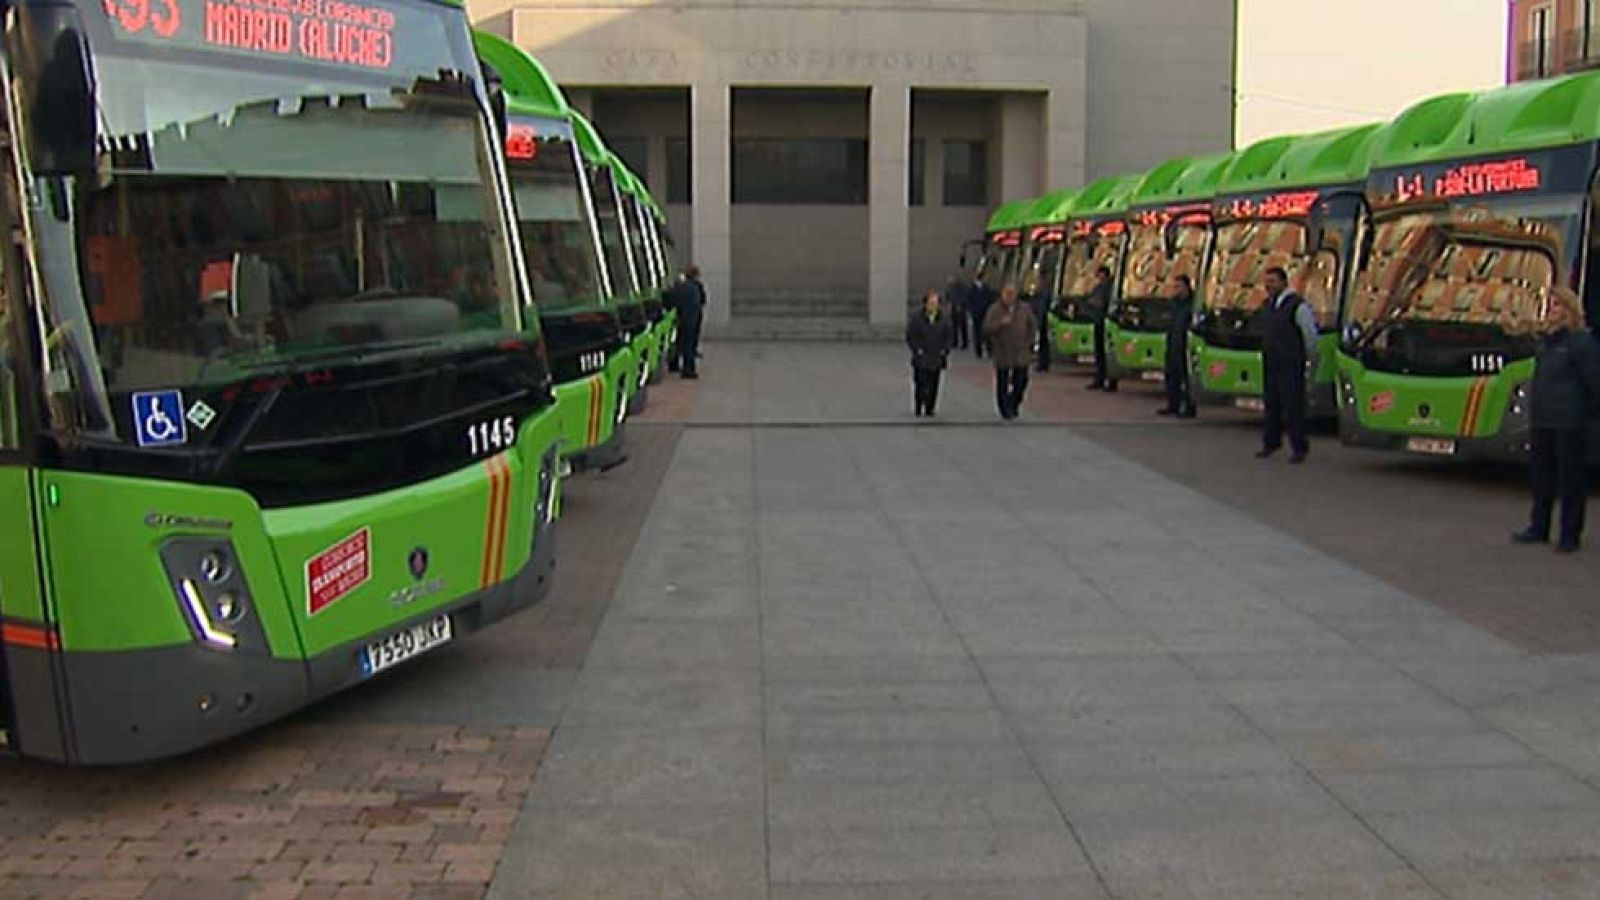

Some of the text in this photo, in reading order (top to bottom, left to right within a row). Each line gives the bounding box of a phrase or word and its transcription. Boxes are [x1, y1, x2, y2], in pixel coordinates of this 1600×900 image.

[205, 2, 393, 67] MADRID (ALUCHE)
[467, 415, 515, 455] 1145
